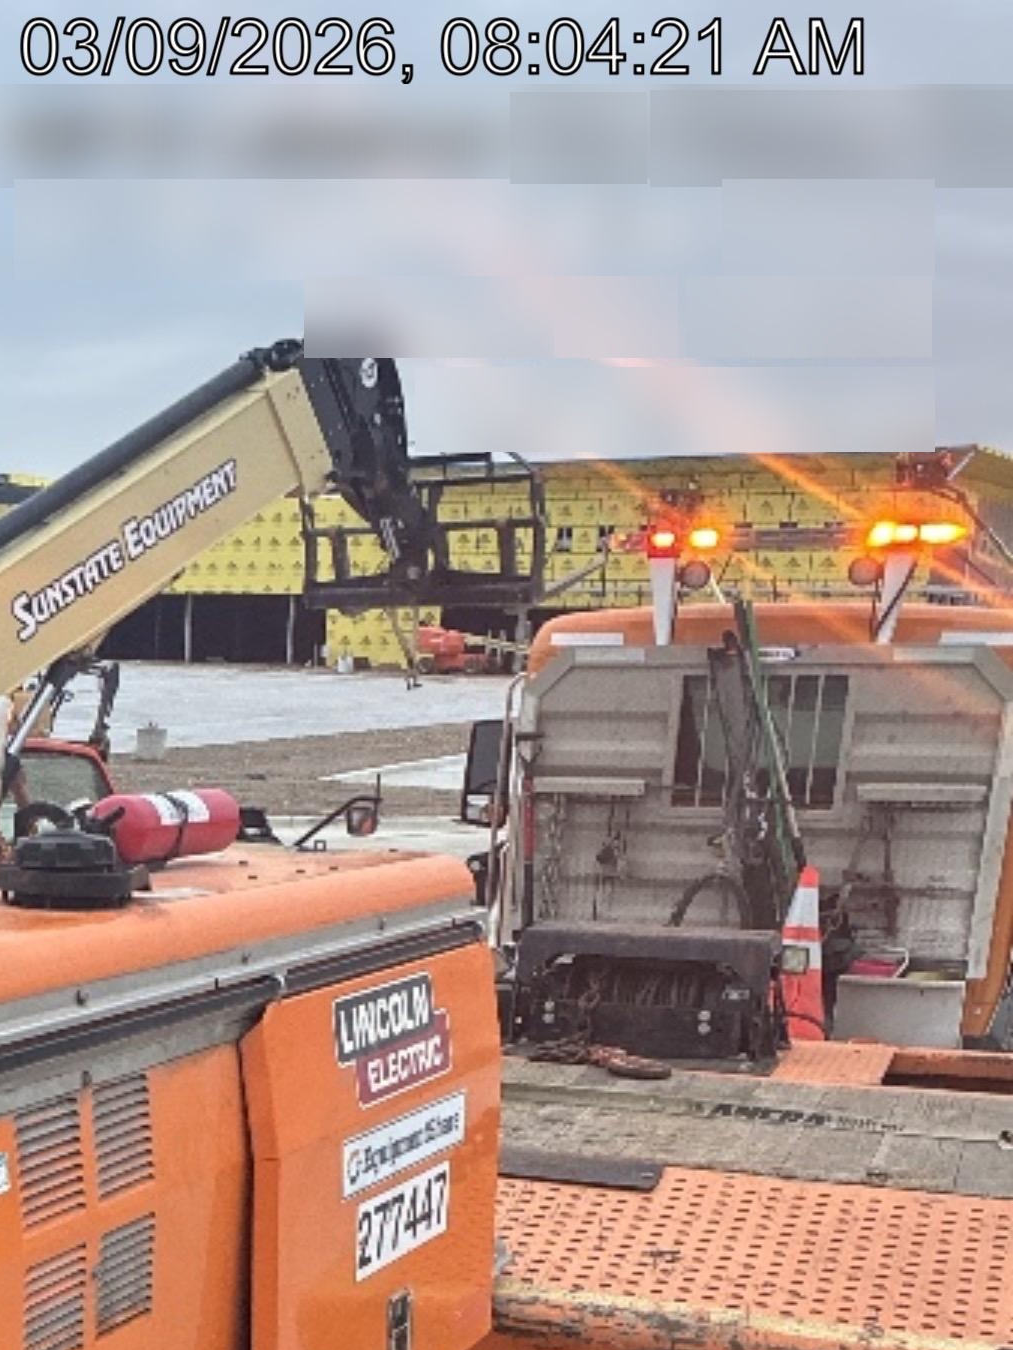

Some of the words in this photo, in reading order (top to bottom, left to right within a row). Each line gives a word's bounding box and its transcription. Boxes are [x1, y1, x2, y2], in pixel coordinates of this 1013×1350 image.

[339, 983, 429, 1054] LINCOLN
[368, 1034, 444, 1093] ELECTRIC
[358, 1169, 447, 1269] 277447
